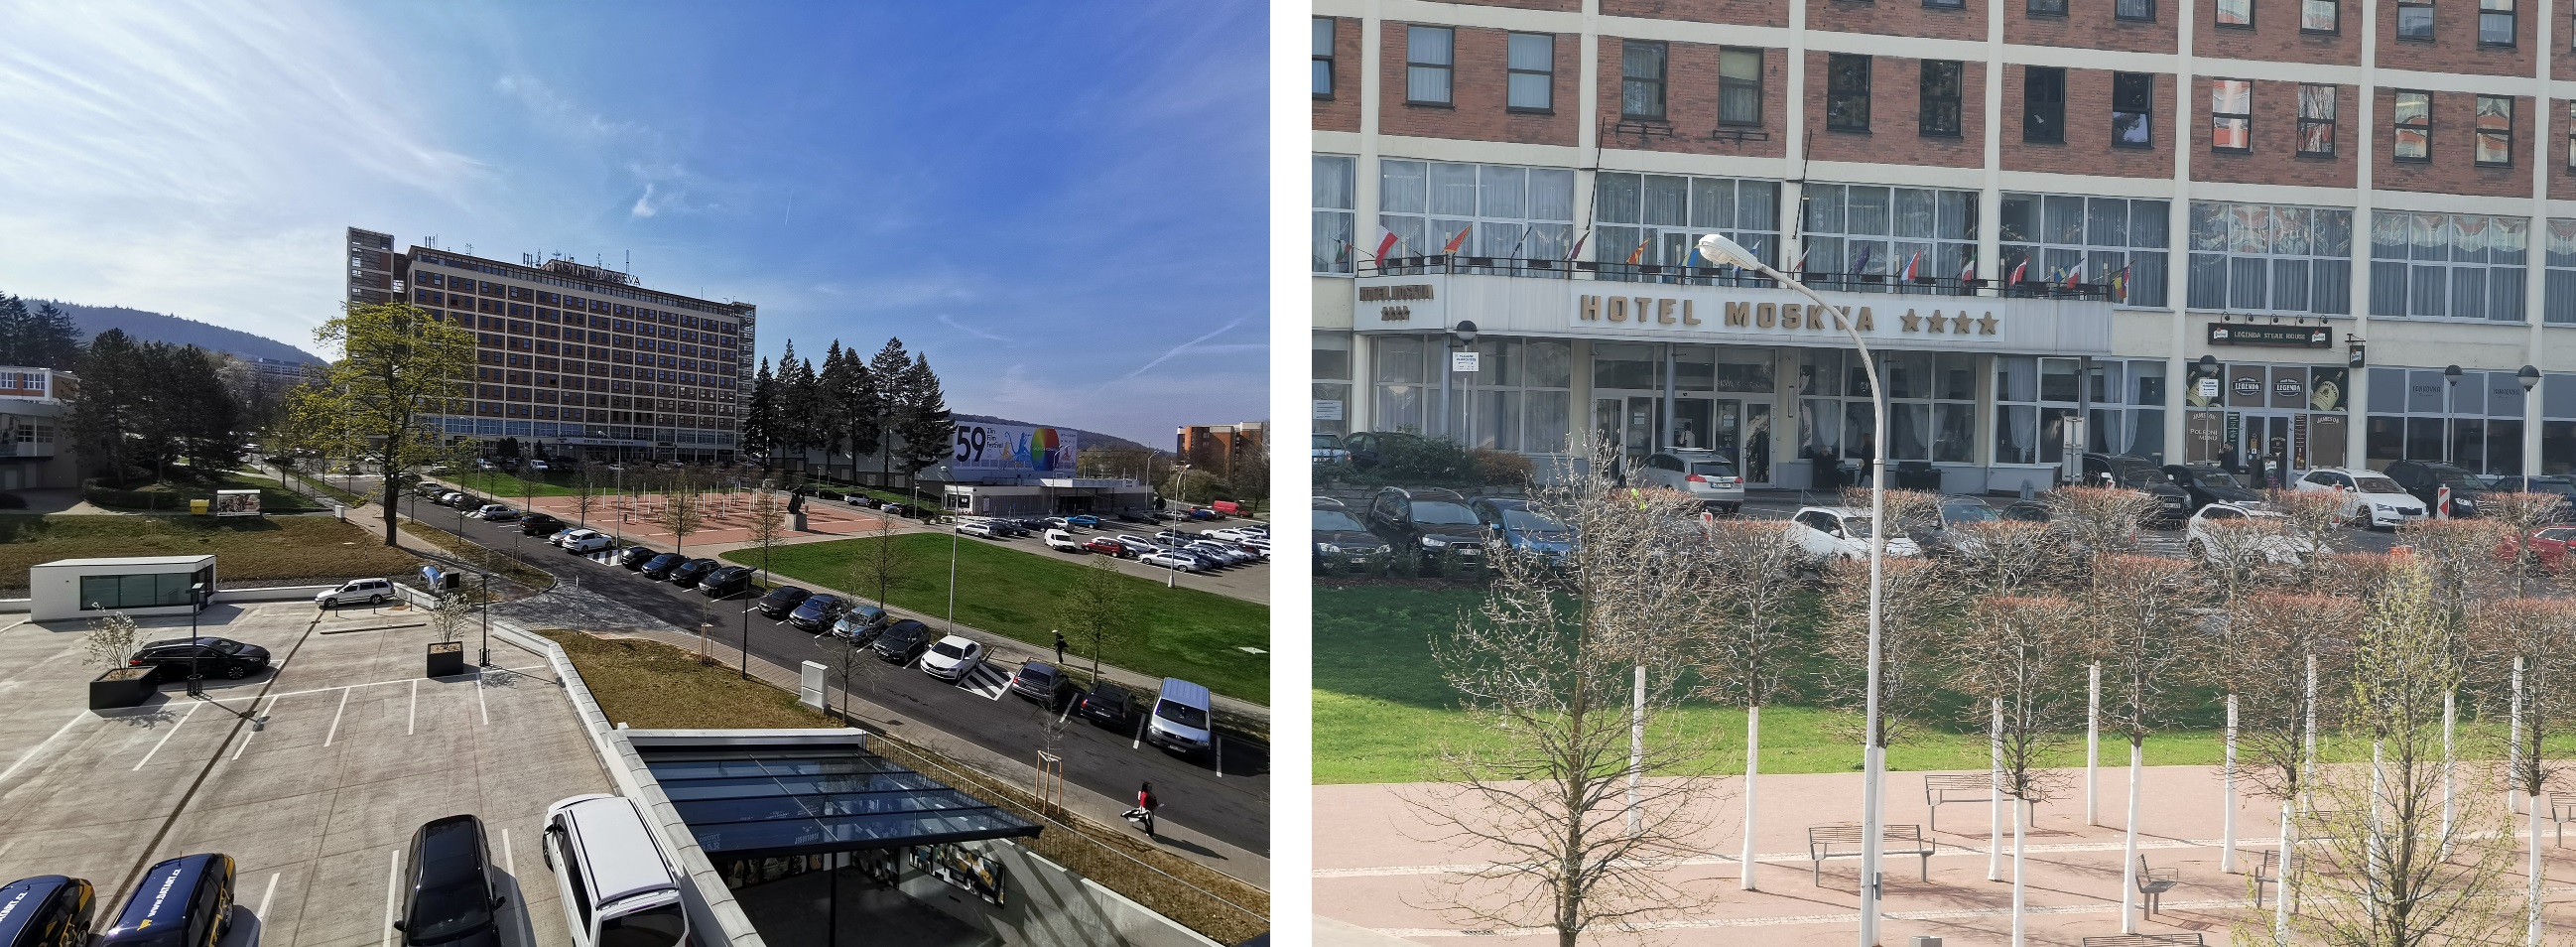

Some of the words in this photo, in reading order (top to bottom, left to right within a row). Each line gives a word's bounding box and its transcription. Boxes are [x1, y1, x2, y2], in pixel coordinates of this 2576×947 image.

[1580, 294, 1702, 326] HOTEL
[1725, 301, 1875, 332] MOSKVA
[2192, 412, 2217, 421] JAMEON
[956, 426, 986, 463] 59
